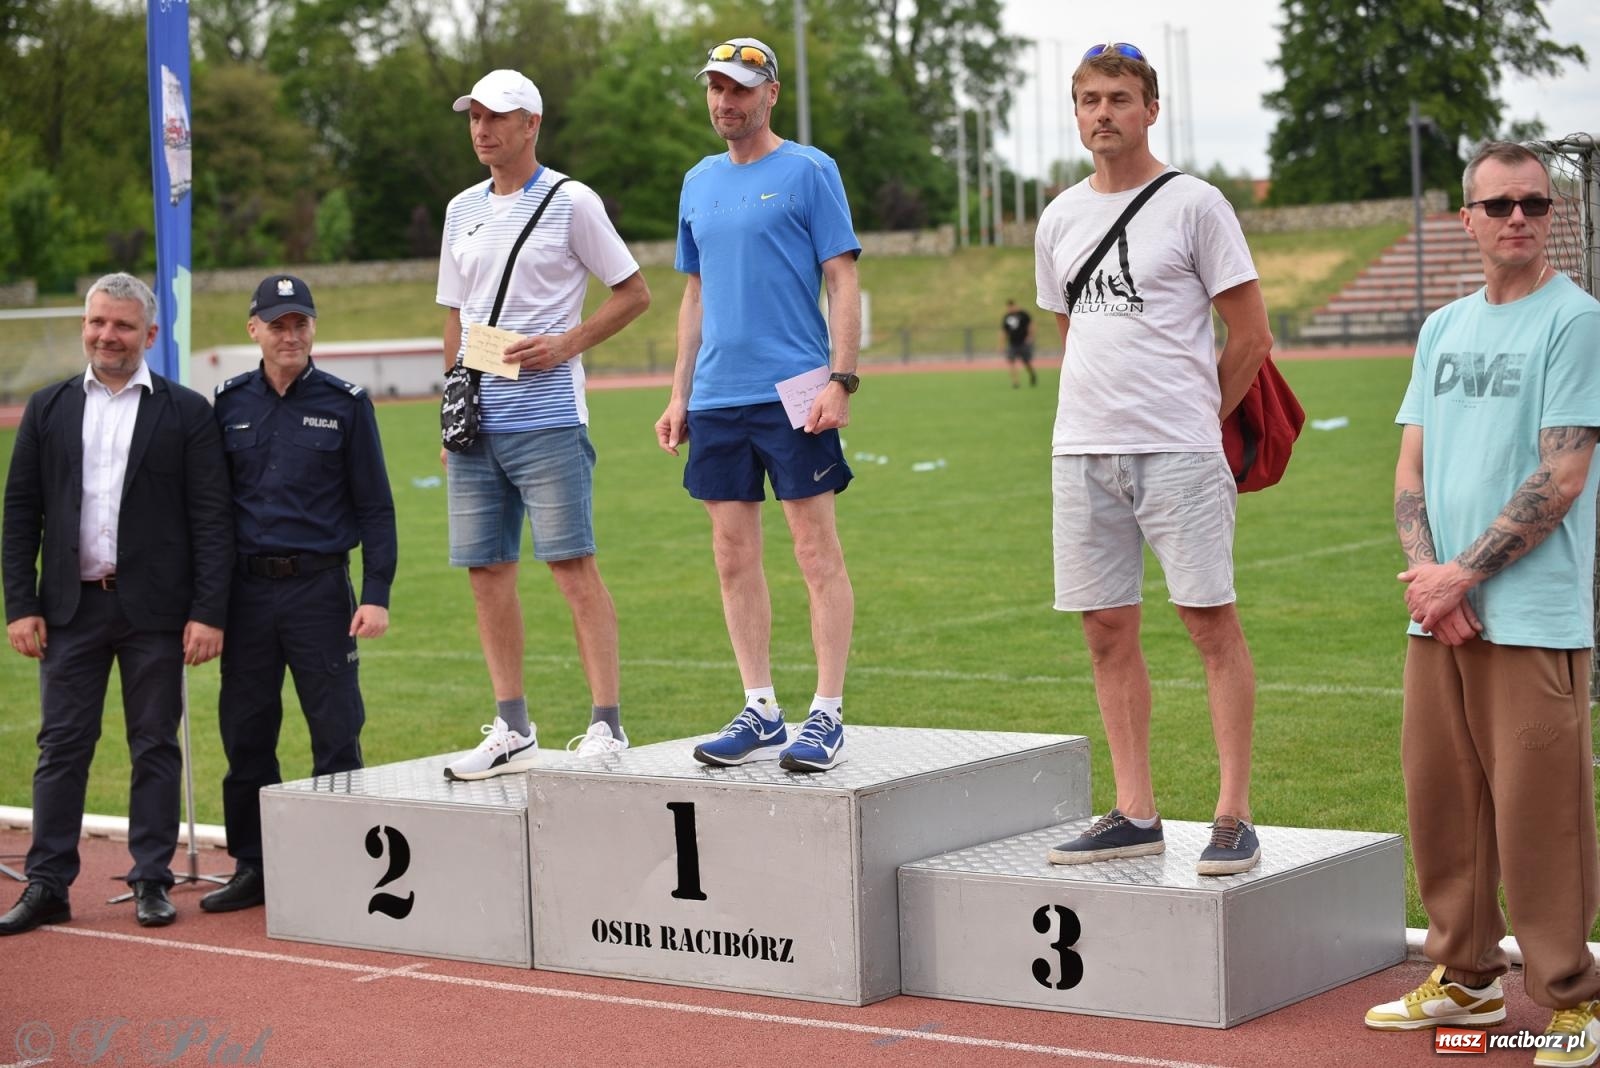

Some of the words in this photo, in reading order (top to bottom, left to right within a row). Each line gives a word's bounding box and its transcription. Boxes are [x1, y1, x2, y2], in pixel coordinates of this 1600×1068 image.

[1073, 303, 1144, 314] OLUTION
[303, 416, 338, 430] POLICJA
[365, 825, 415, 920] 2
[666, 802, 708, 901] 1
[592, 918, 653, 948] OSIR
[660, 928, 795, 964] RACIBÓRZ
[1031, 904, 1084, 991] 3
